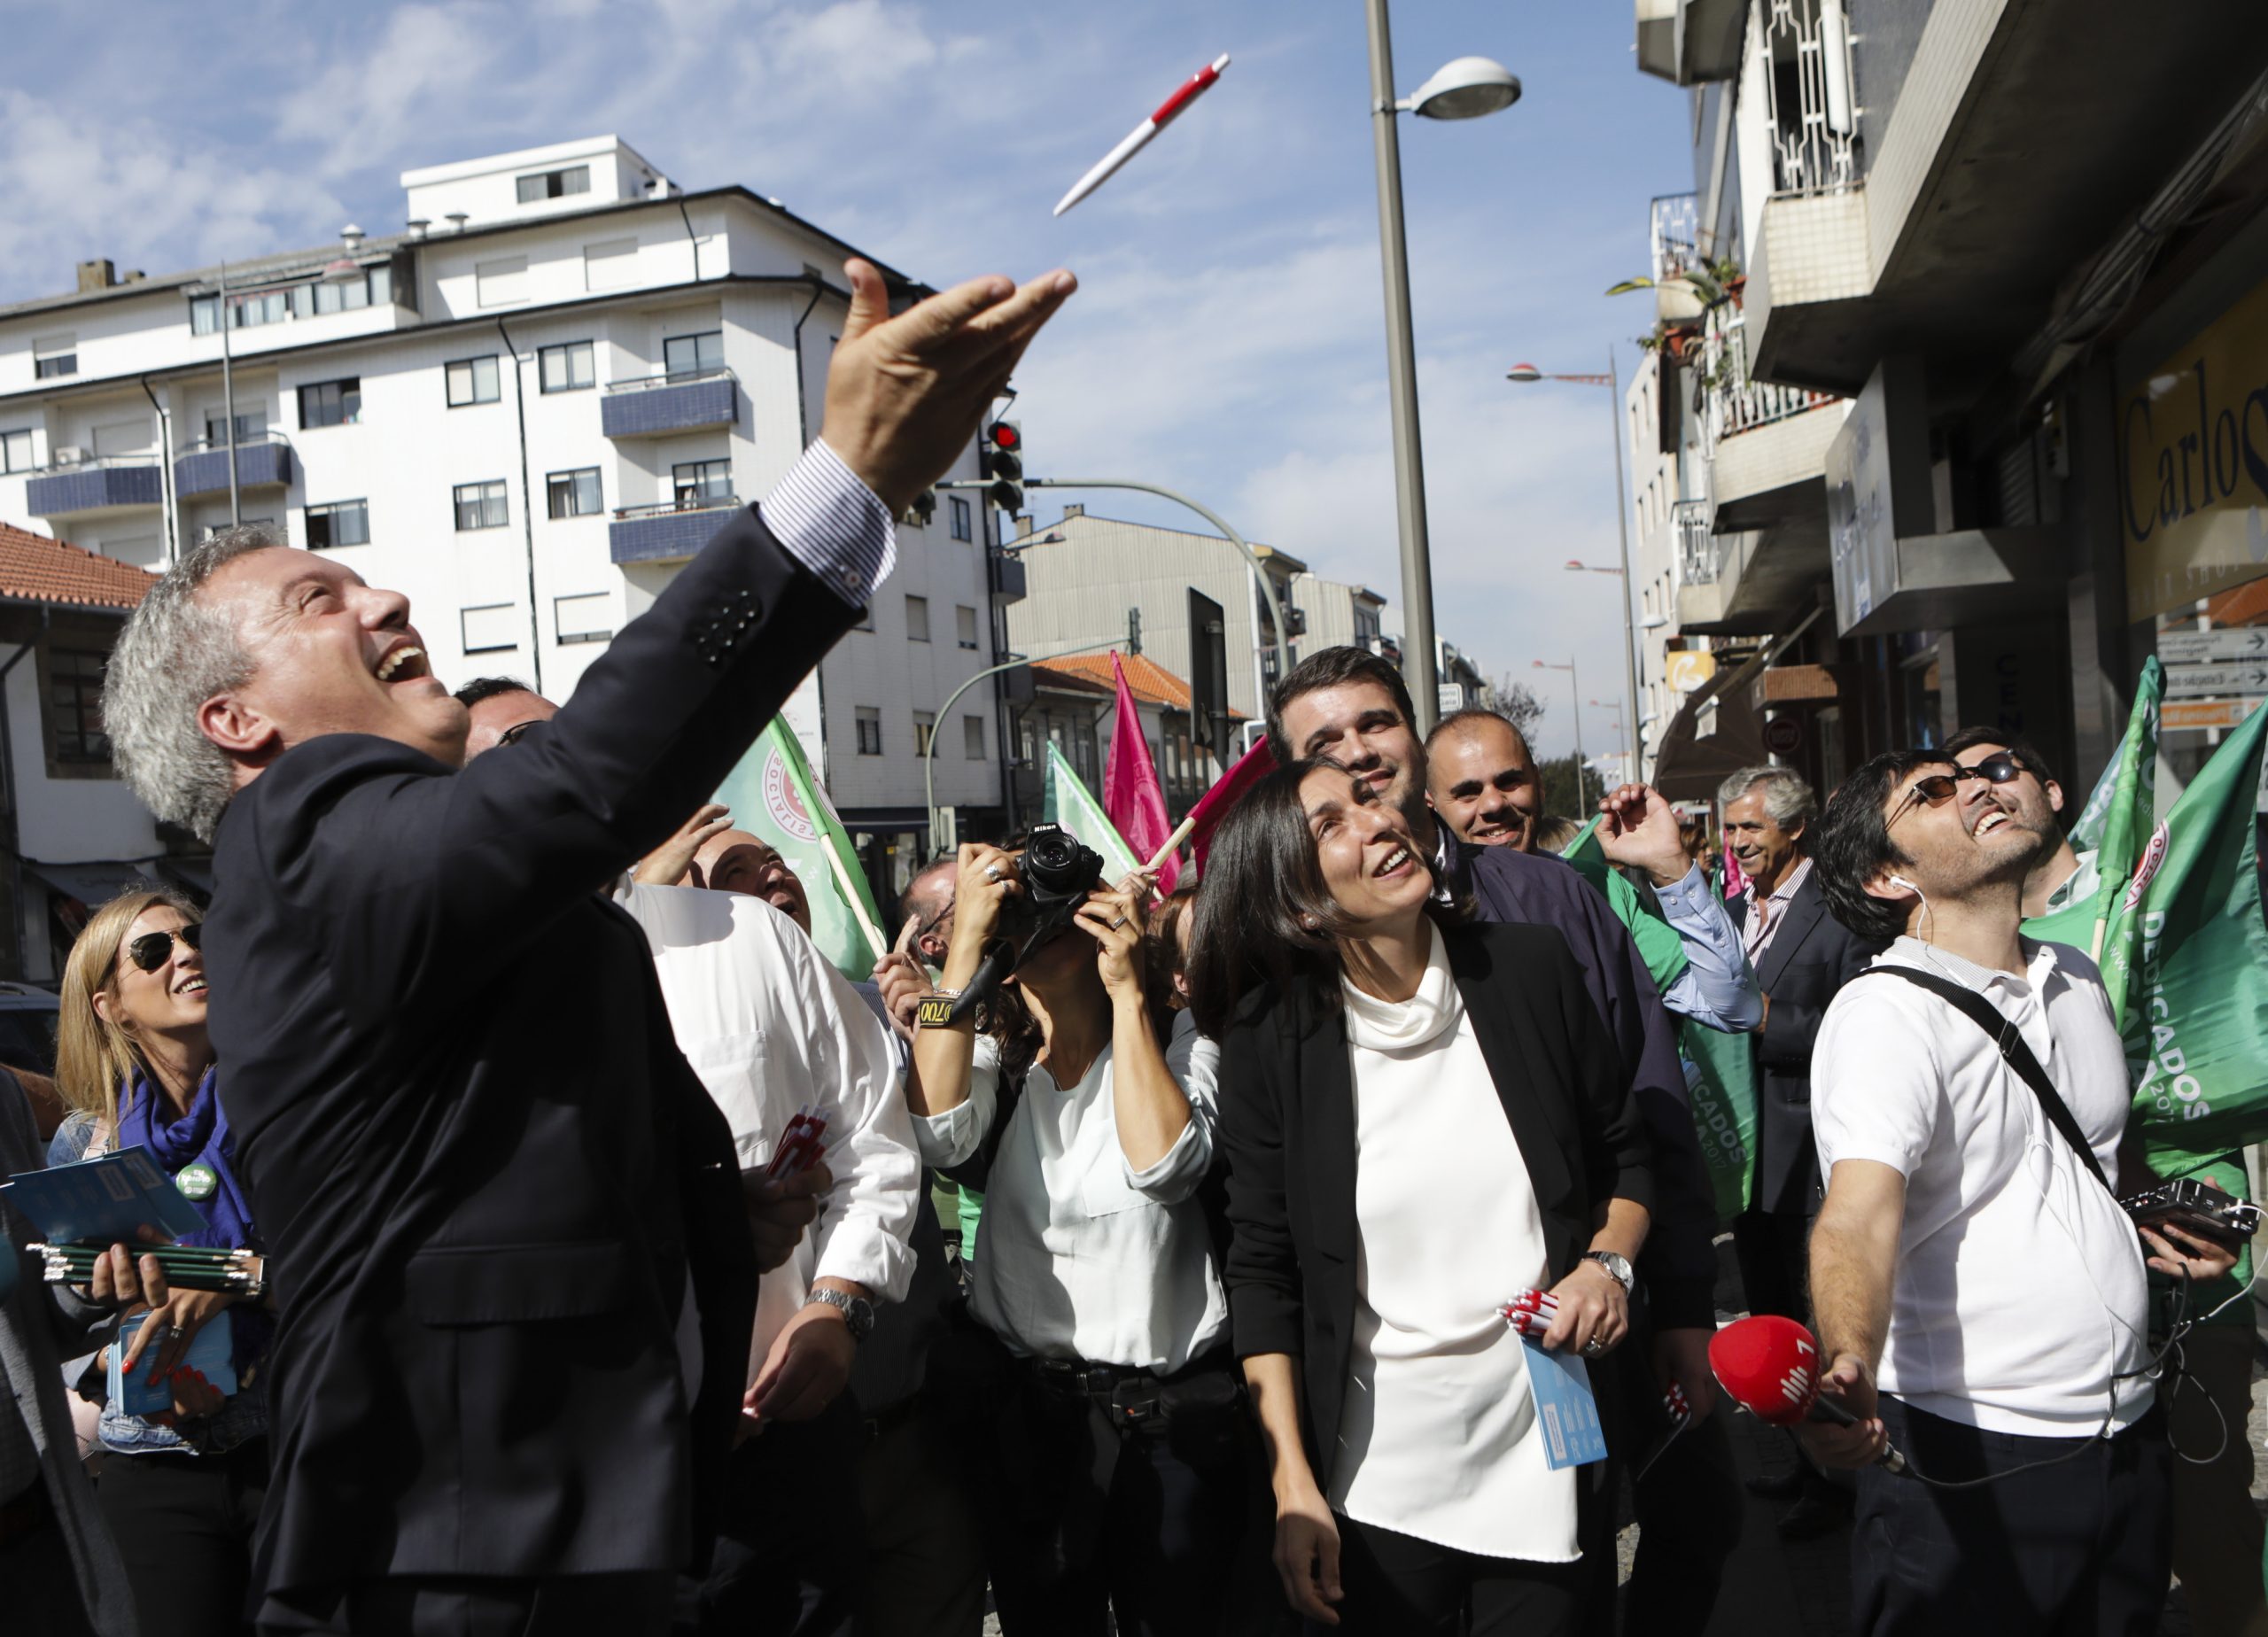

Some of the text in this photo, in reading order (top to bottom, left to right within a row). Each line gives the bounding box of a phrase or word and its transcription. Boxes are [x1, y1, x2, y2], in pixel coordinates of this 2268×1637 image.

[1034, 824, 1056, 833] Nikon
[2137, 910, 2211, 1121] DEDICADOS
[1702, 1138, 1728, 1168] 2017
